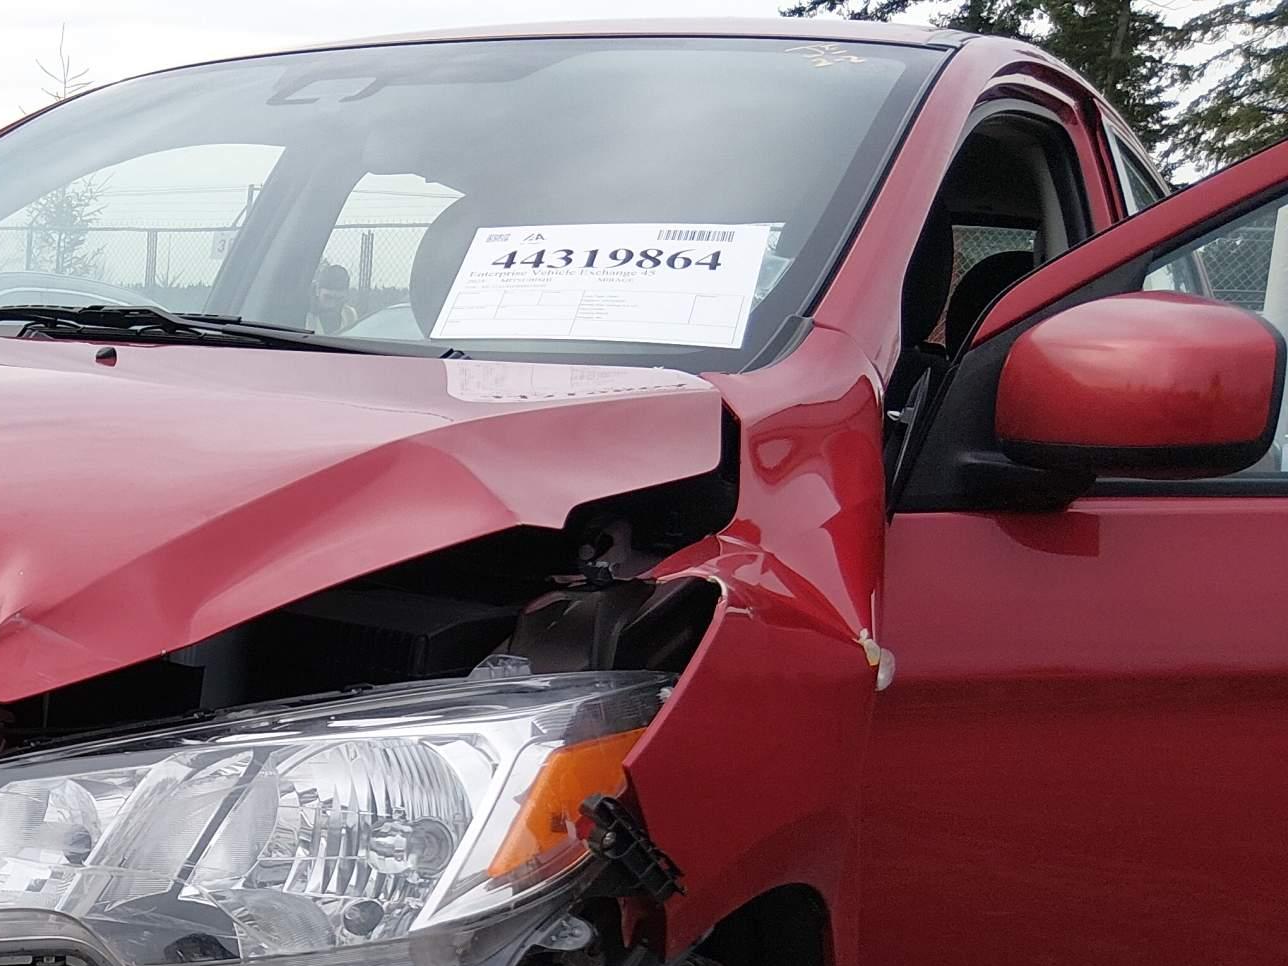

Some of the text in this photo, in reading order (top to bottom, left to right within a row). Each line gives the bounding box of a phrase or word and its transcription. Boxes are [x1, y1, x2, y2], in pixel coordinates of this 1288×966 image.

[491, 248, 722, 271] 44319864
[532, 269, 577, 277] Vehicle
[579, 269, 638, 278] Exchange
